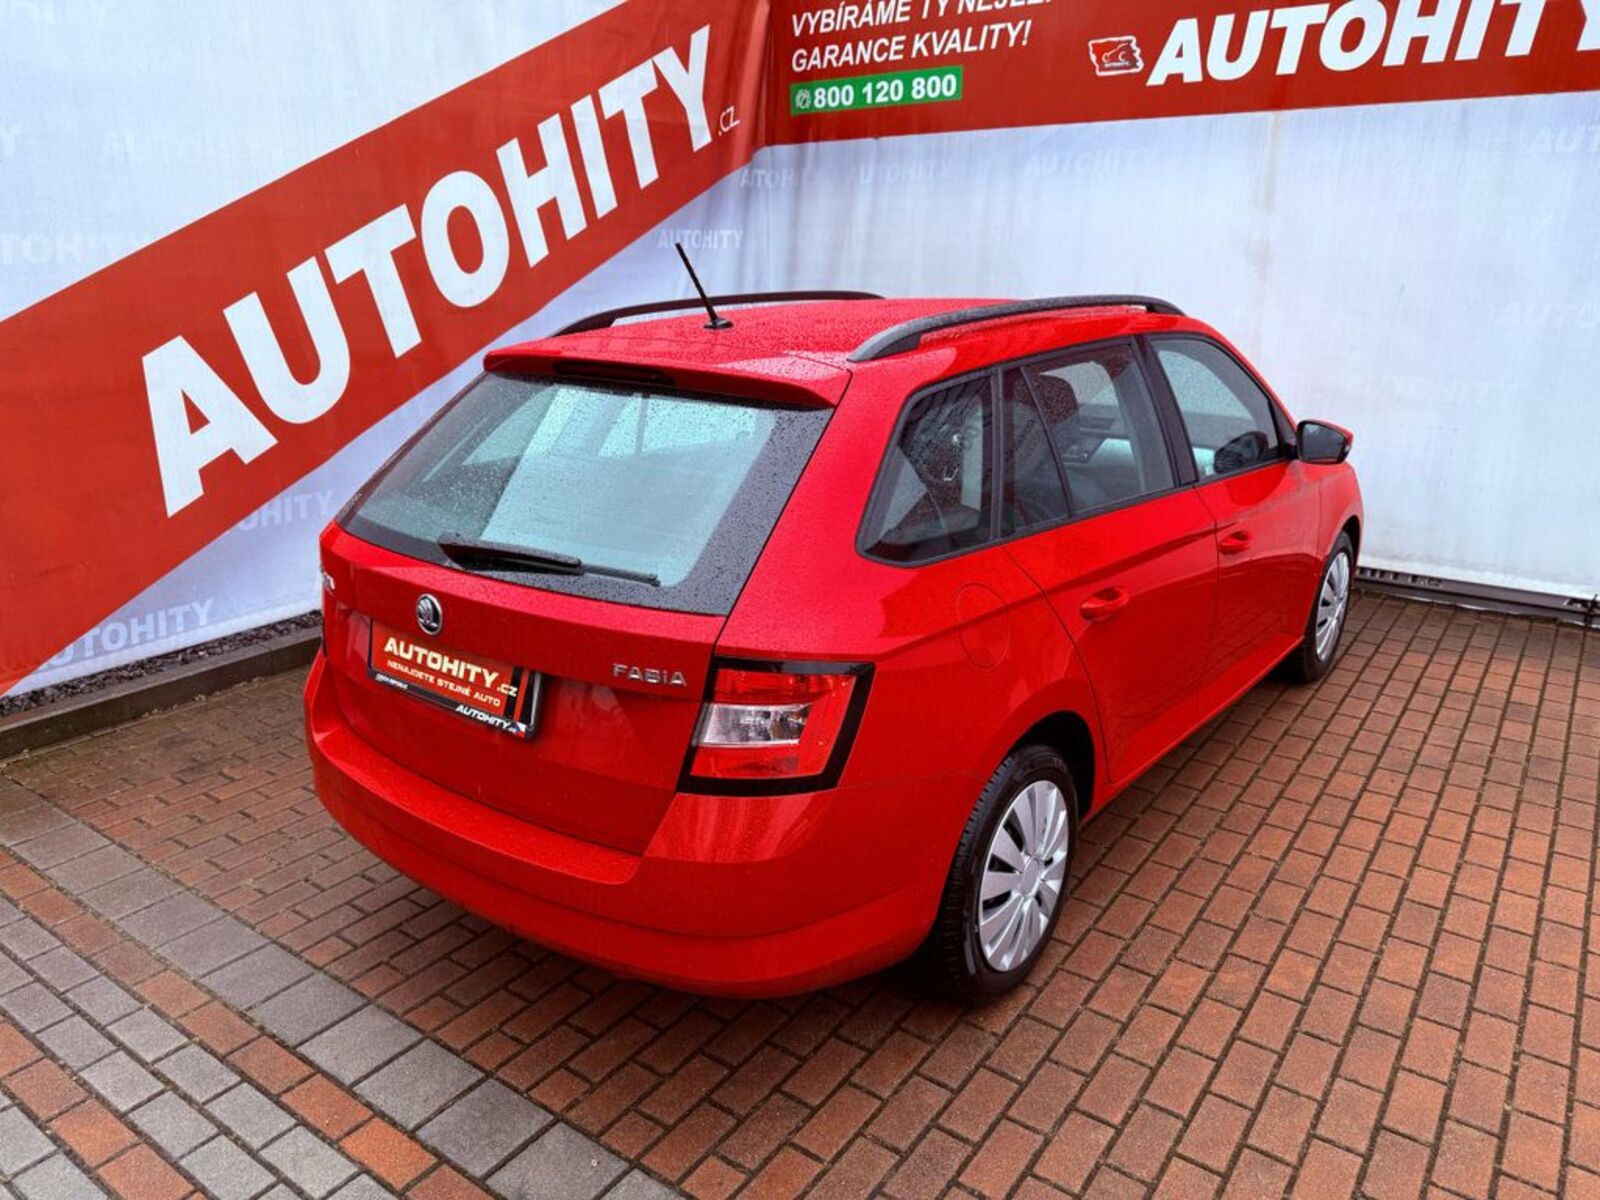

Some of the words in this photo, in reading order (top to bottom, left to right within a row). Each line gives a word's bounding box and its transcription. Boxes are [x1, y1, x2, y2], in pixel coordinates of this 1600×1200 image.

[792, 0, 912, 37] VYBÍRÁME
[791, 36, 907, 72] GARANCE
[911, 19, 1033, 58] KVALITY!
[813, 84, 854, 109] 800
[862, 79, 904, 104] 120
[911, 74, 957, 99] 800
[50, 598, 214, 666] UTOHITY
[473, 691, 501, 707] AUTO
